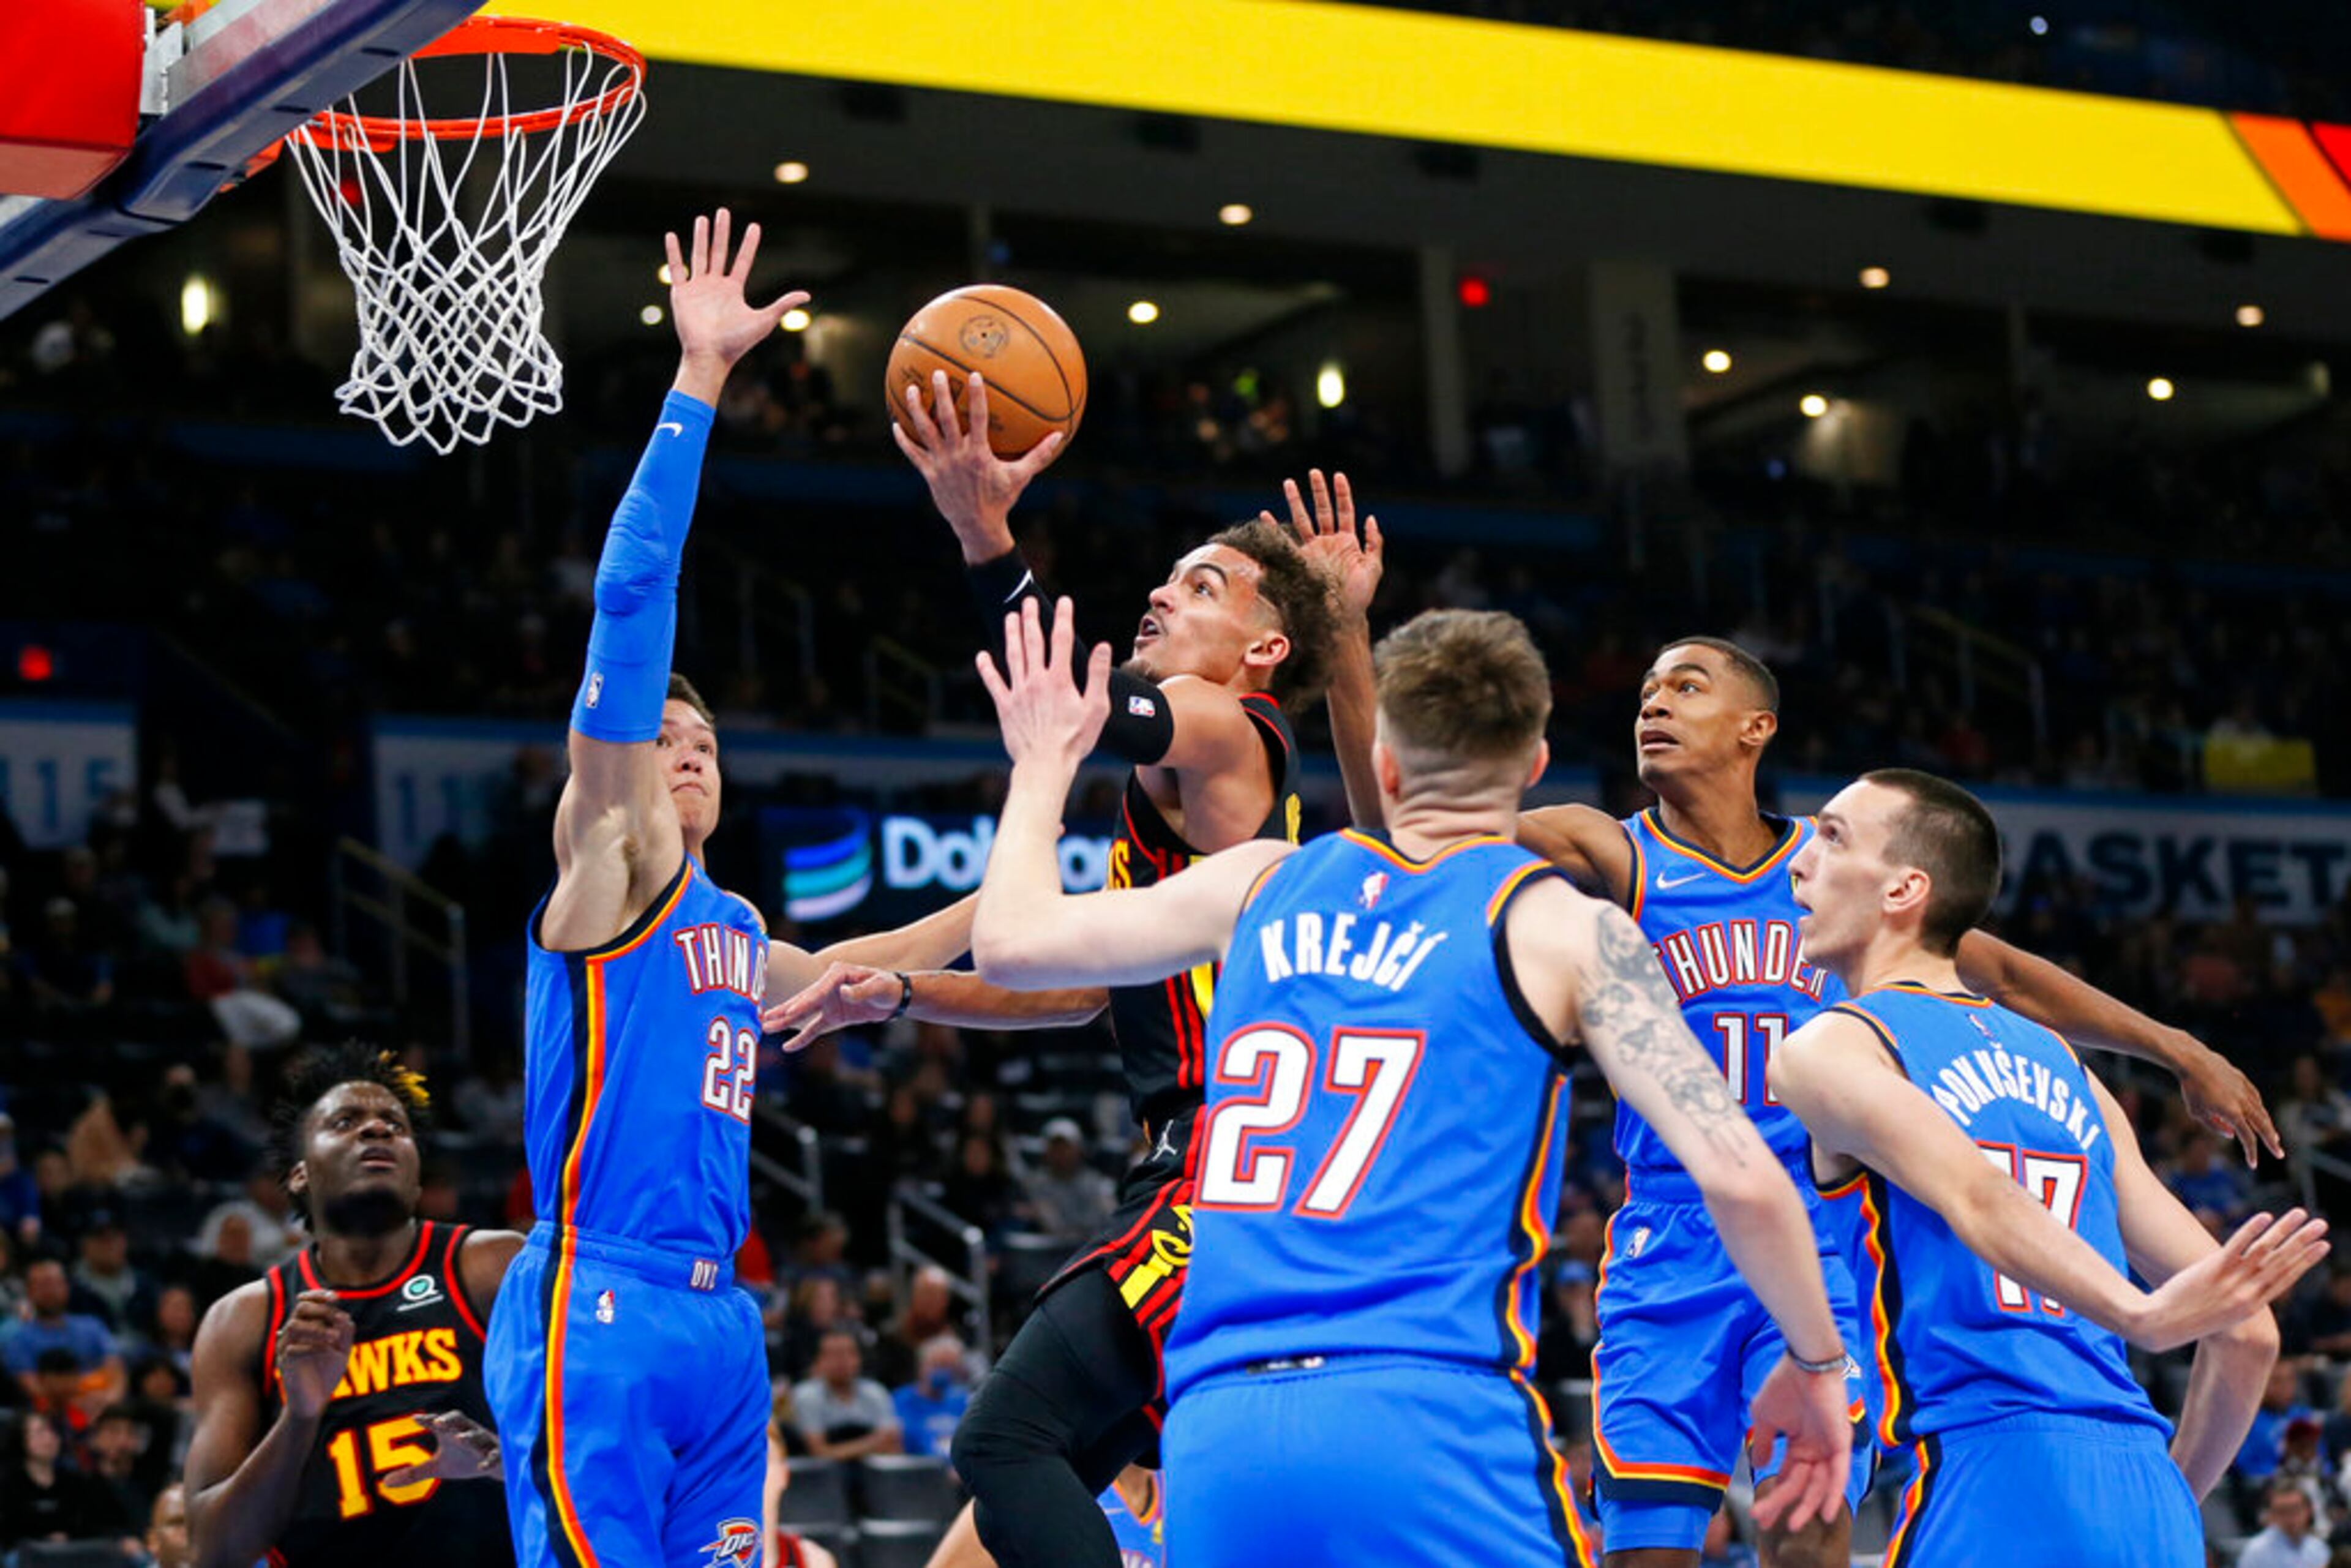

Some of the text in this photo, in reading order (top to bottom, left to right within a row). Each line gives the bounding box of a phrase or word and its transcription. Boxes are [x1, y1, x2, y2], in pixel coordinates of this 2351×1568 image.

[882, 816, 1109, 891] Doo
[2002, 833, 2344, 911] ASKET
[1260, 912, 1447, 992] KREJČÍ
[701, 1016, 759, 1124] 22
[1931, 1042, 2100, 1150] POKUŠEVSKI
[1192, 1021, 1427, 1220] 27
[274, 1327, 463, 1407] WKS
[326, 1411, 441, 1521] 15
